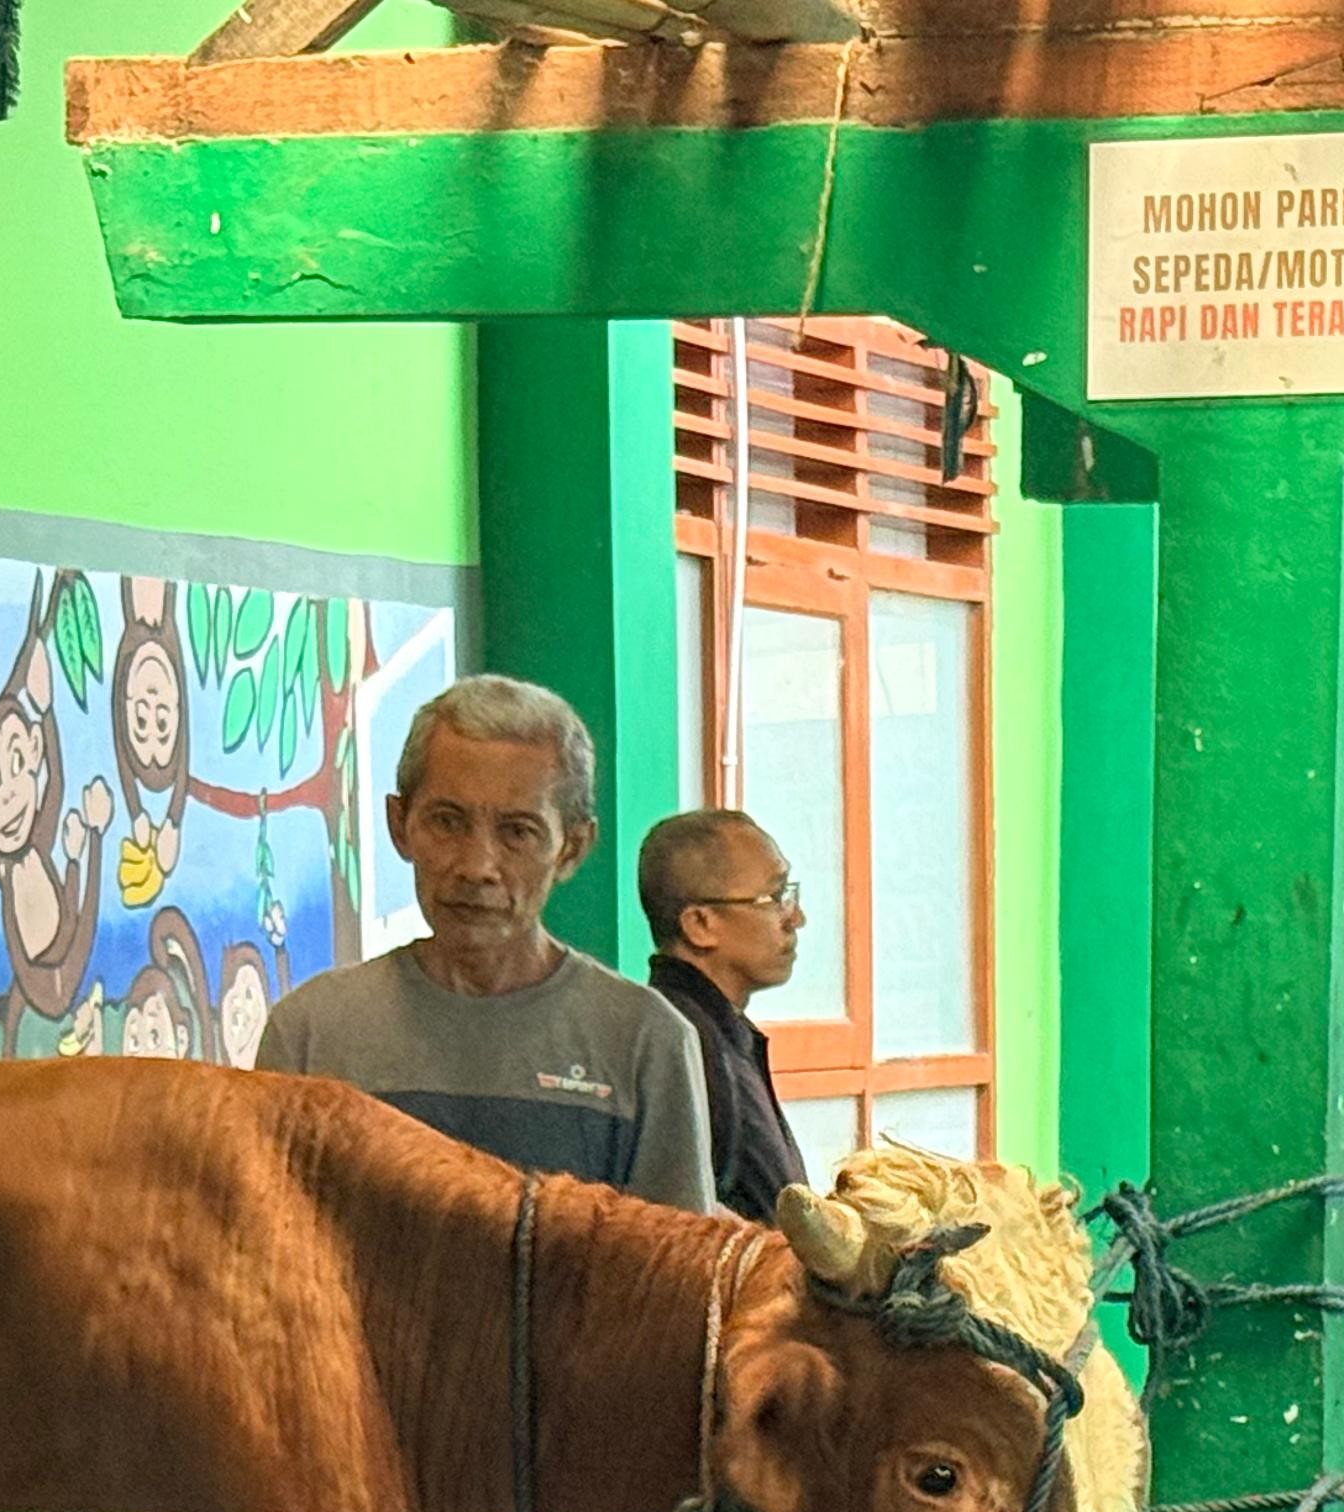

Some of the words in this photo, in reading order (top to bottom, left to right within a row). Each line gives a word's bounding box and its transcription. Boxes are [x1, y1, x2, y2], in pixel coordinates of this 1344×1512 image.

[1143, 191, 1261, 233] MOHON
[1119, 305, 1187, 343] RAPI
[1200, 302, 1259, 340] DAN
